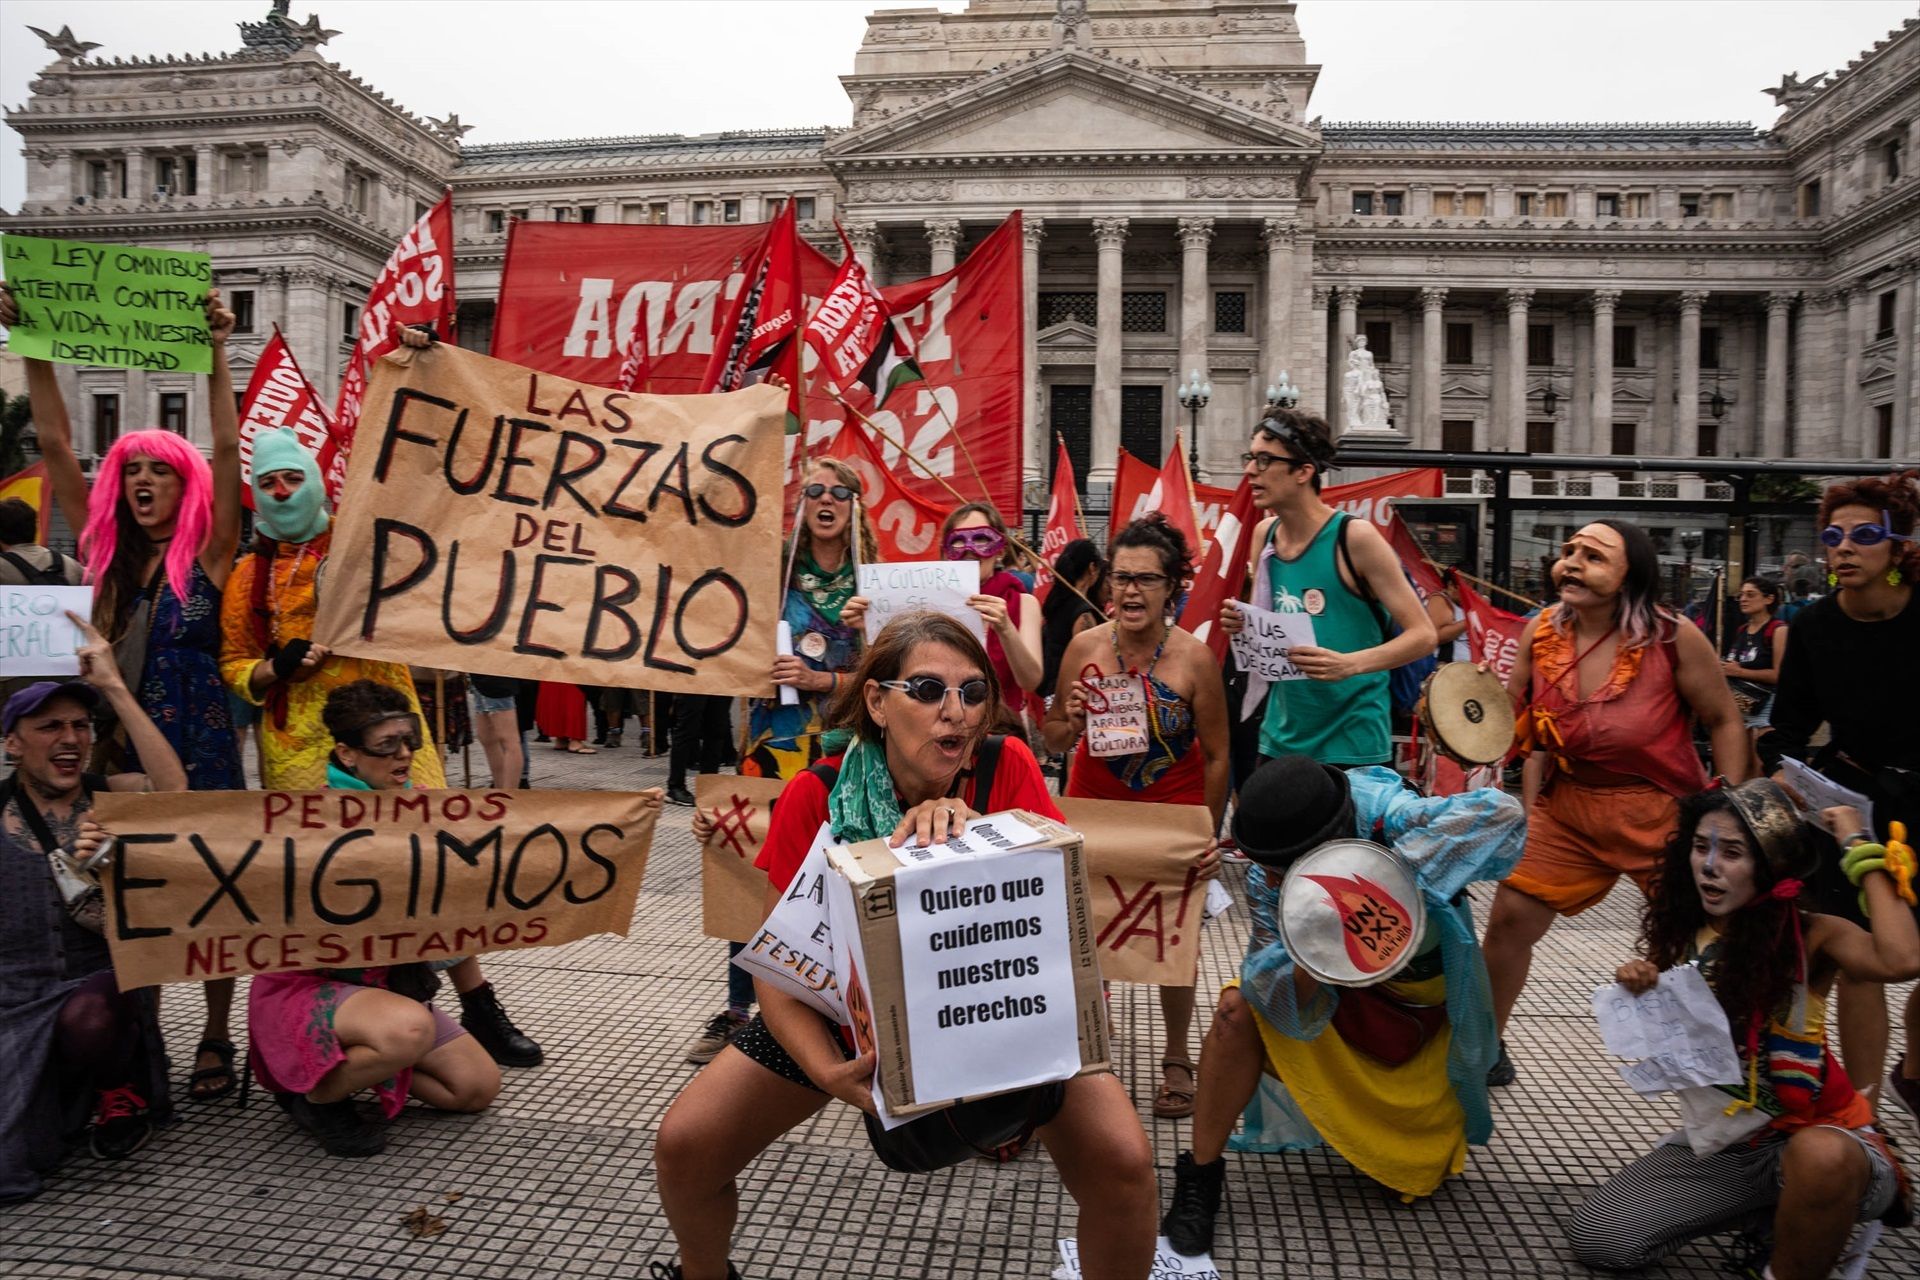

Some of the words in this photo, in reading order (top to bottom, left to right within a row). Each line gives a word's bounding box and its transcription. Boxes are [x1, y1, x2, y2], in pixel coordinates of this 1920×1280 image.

[970, 182, 1070, 197] CONGRESO
[1079, 181, 1171, 196] NACIONAL
[6, 243, 30, 260] LA
[52, 241, 106, 281] LEY
[115, 253, 211, 282] OMNIBUS
[10, 275, 100, 303] ATENTA
[114, 286, 208, 313] CONTRA
[17, 311, 38, 329] LA
[44, 306, 112, 336] VIDA
[133, 319, 214, 347] NUESTRA
[51, 340, 180, 370] IDENTIDAD
[526, 373, 634, 433] LAS
[373, 387, 757, 527] FUERZAS
[512, 512, 596, 556] DEL
[360, 517, 749, 676] PUEBLO
[863, 567, 882, 590] LA
[888, 567, 961, 590] CULTURA
[0, 593, 58, 617] RO
[1259, 617, 1286, 640] LAS
[1111, 691, 1135, 703] LEY
[1091, 716, 1139, 728] ARRIBA
[1092, 731, 1106, 739] LA
[263, 792, 514, 833] PEDIMOS
[1069, 846, 1080, 877] 900ml
[113, 823, 625, 940] EXIGIMOS
[787, 872, 825, 906] LA
[920, 882, 996, 913] Quiero
[1002, 875, 1044, 908] que
[1073, 881, 1084, 895] DE
[930, 914, 1042, 952] cuidemos
[1075, 897, 1091, 955] UNIDADES
[1096, 866, 1199, 963] YA!
[185, 916, 549, 976] NECESITAMOS
[937, 954, 1040, 990] nuestros
[937, 992, 1047, 1030] derechos
